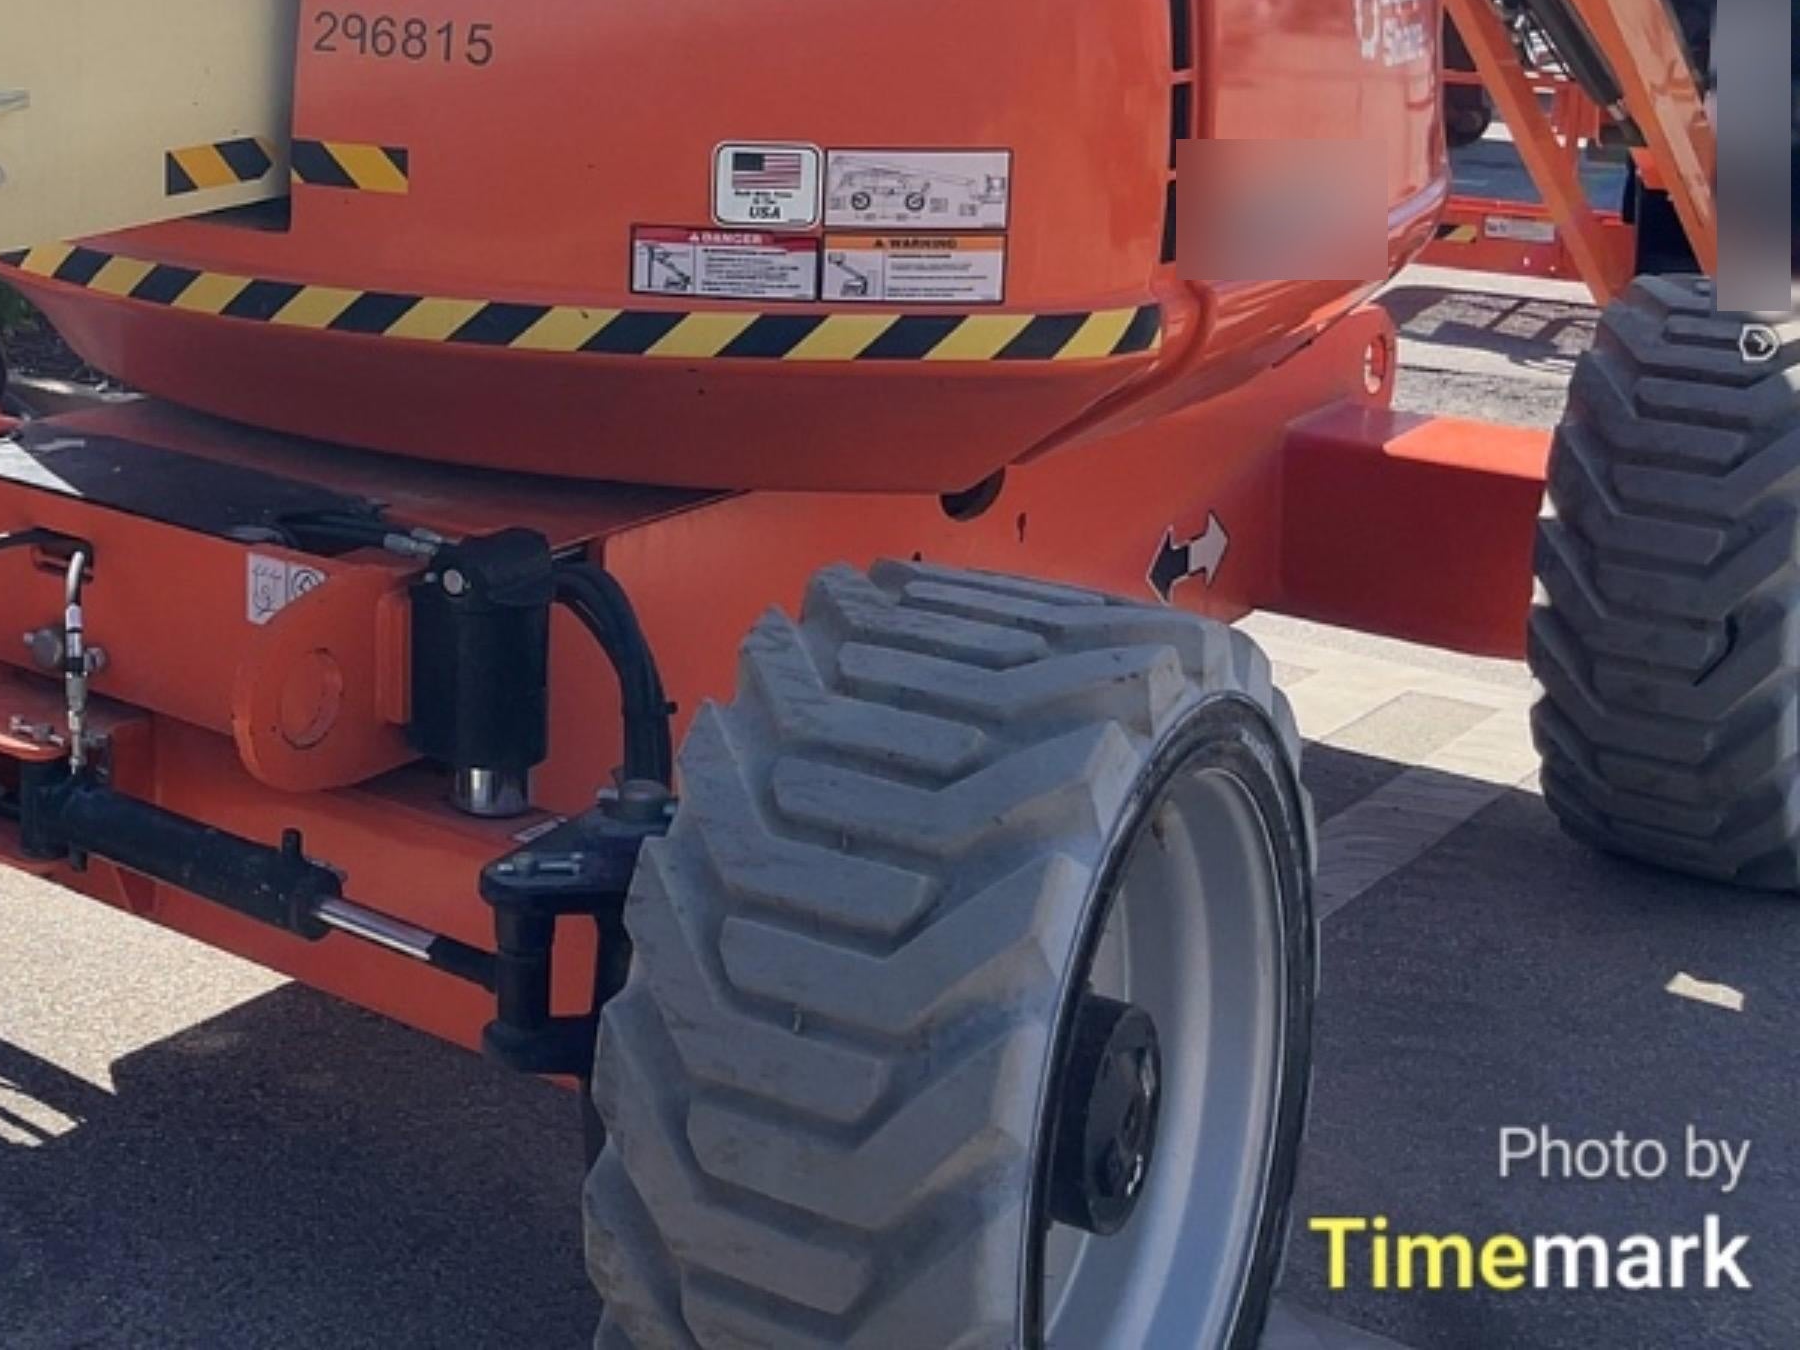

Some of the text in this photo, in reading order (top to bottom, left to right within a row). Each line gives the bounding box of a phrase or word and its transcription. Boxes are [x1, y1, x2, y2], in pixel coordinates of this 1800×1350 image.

[312, 9, 494, 67] 296815
[748, 205, 782, 219] USA
[701, 232, 763, 245] DANGER
[888, 238, 958, 249] WARNING
